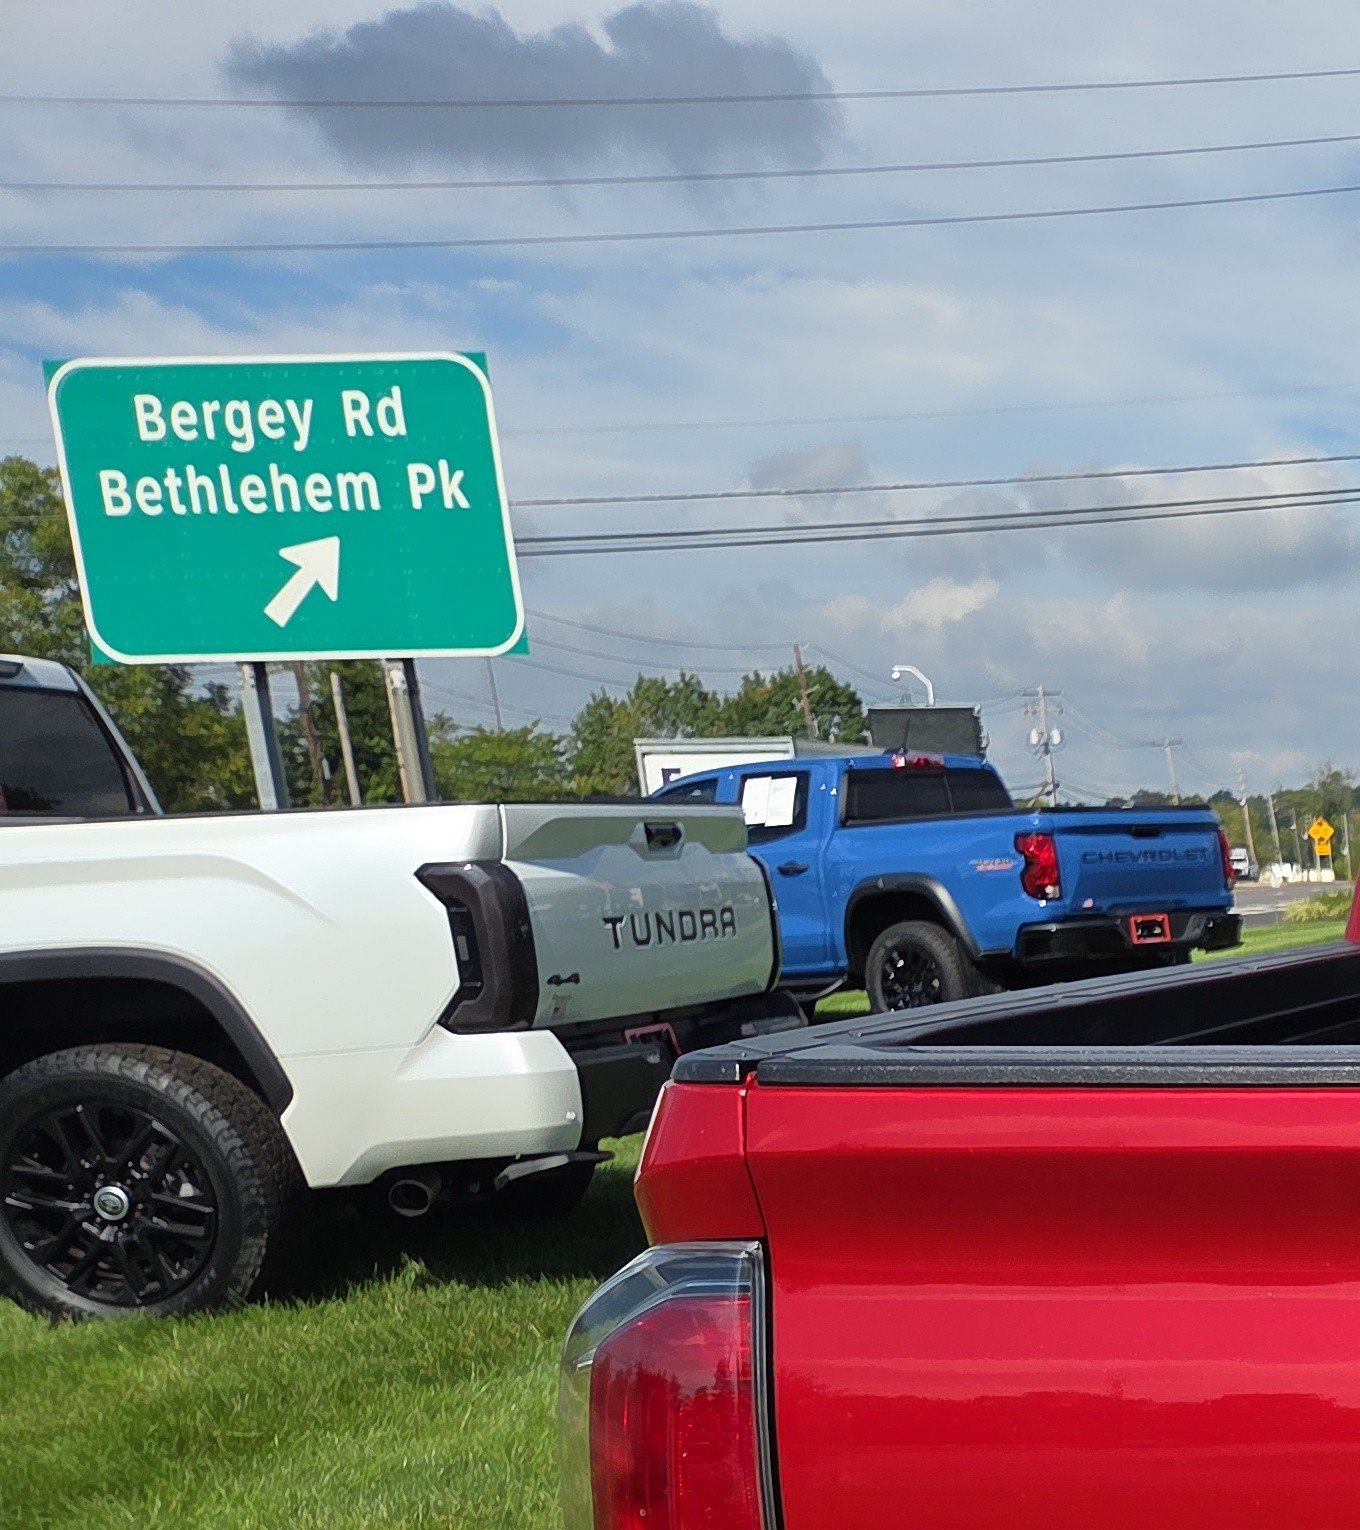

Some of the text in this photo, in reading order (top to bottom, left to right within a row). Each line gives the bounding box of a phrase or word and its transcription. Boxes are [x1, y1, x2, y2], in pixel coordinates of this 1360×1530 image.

[134, 385, 407, 452] Bergey Rd
[98, 459, 471, 517] Bethlehem Pk
[1081, 847, 1209, 865] CHEVROLET
[603, 904, 738, 951] TUNDRA
